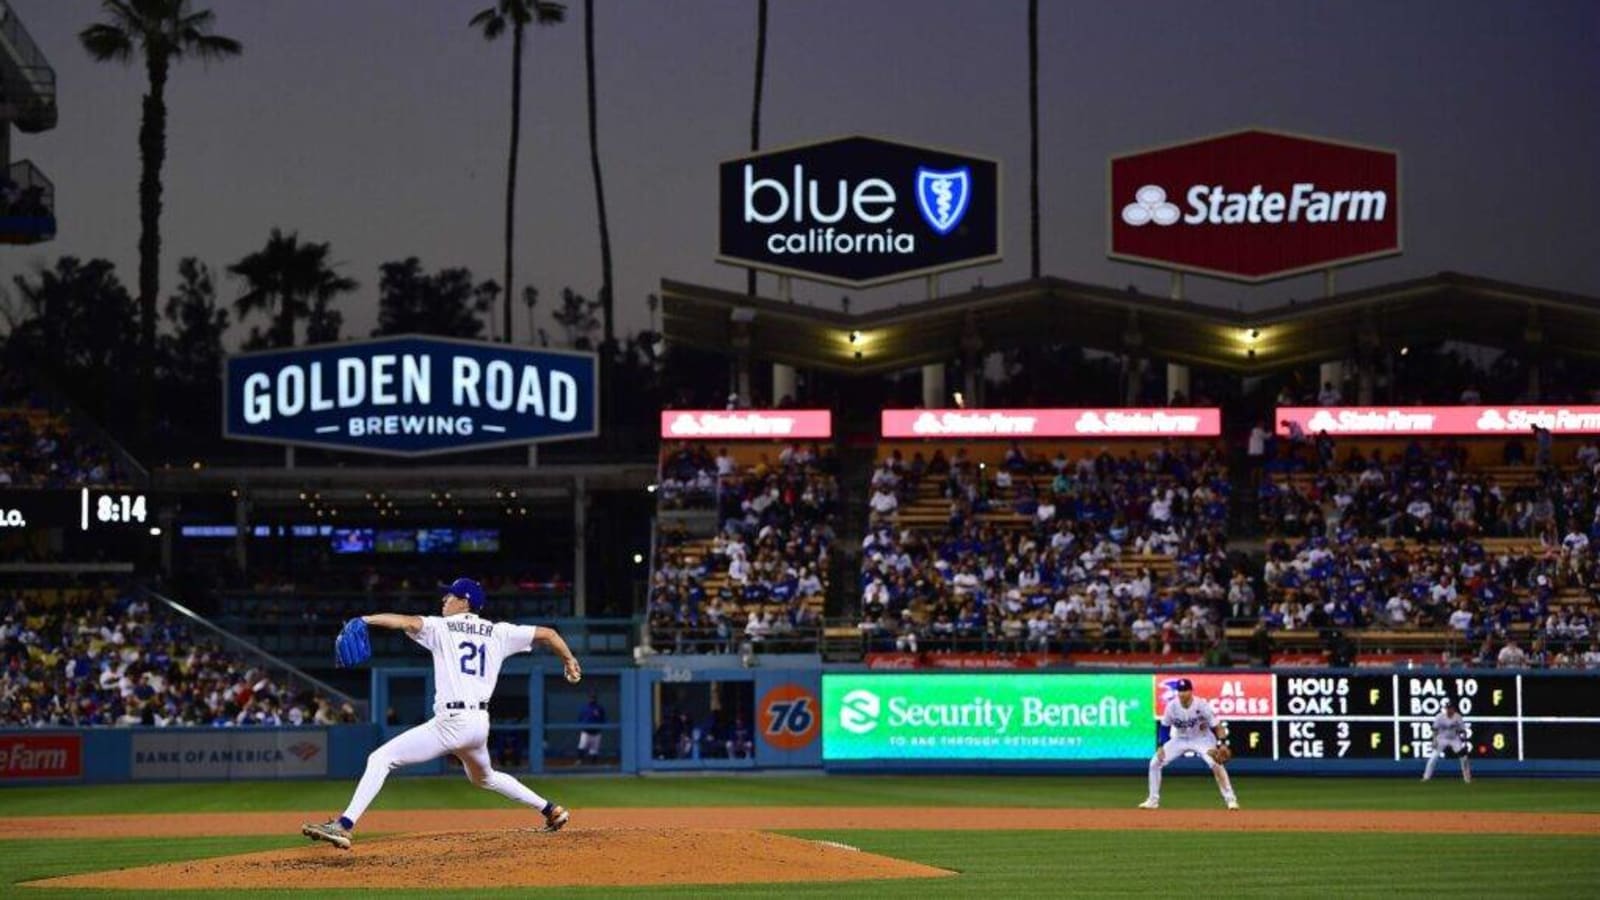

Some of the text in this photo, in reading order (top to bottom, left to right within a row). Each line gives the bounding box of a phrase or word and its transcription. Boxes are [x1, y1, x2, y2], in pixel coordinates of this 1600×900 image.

[745, 164, 896, 223] blue
[767, 228, 914, 253] california
[243, 354, 578, 424] GOLDEN ROAD
[348, 416, 474, 436] BREWING
[97, 495, 147, 522] 8:14
[459, 641, 486, 677] 21
[1220, 681, 1244, 697] AL
[1288, 678, 1350, 695] HOU 5
[1410, 678, 1478, 696] BAL 10
[1370, 688, 1380, 705] F
[1493, 689, 1503, 706] F
[1210, 698, 1269, 714] CORES
[1288, 697, 1347, 714] OAK 1
[1458, 697, 1472, 715] 0
[767, 697, 813, 735] 76
[888, 697, 1013, 733] Security
[1289, 722, 1350, 739] KC 3
[1410, 722, 1433, 739] TB
[1249, 732, 1260, 748] F
[1371, 732, 1381, 749] F
[1493, 733, 1505, 750] 8
[135, 749, 284, 763] BANK OF AMERICA
[1289, 740, 1351, 758] CLE 7
[1410, 741, 1446, 758] TE
